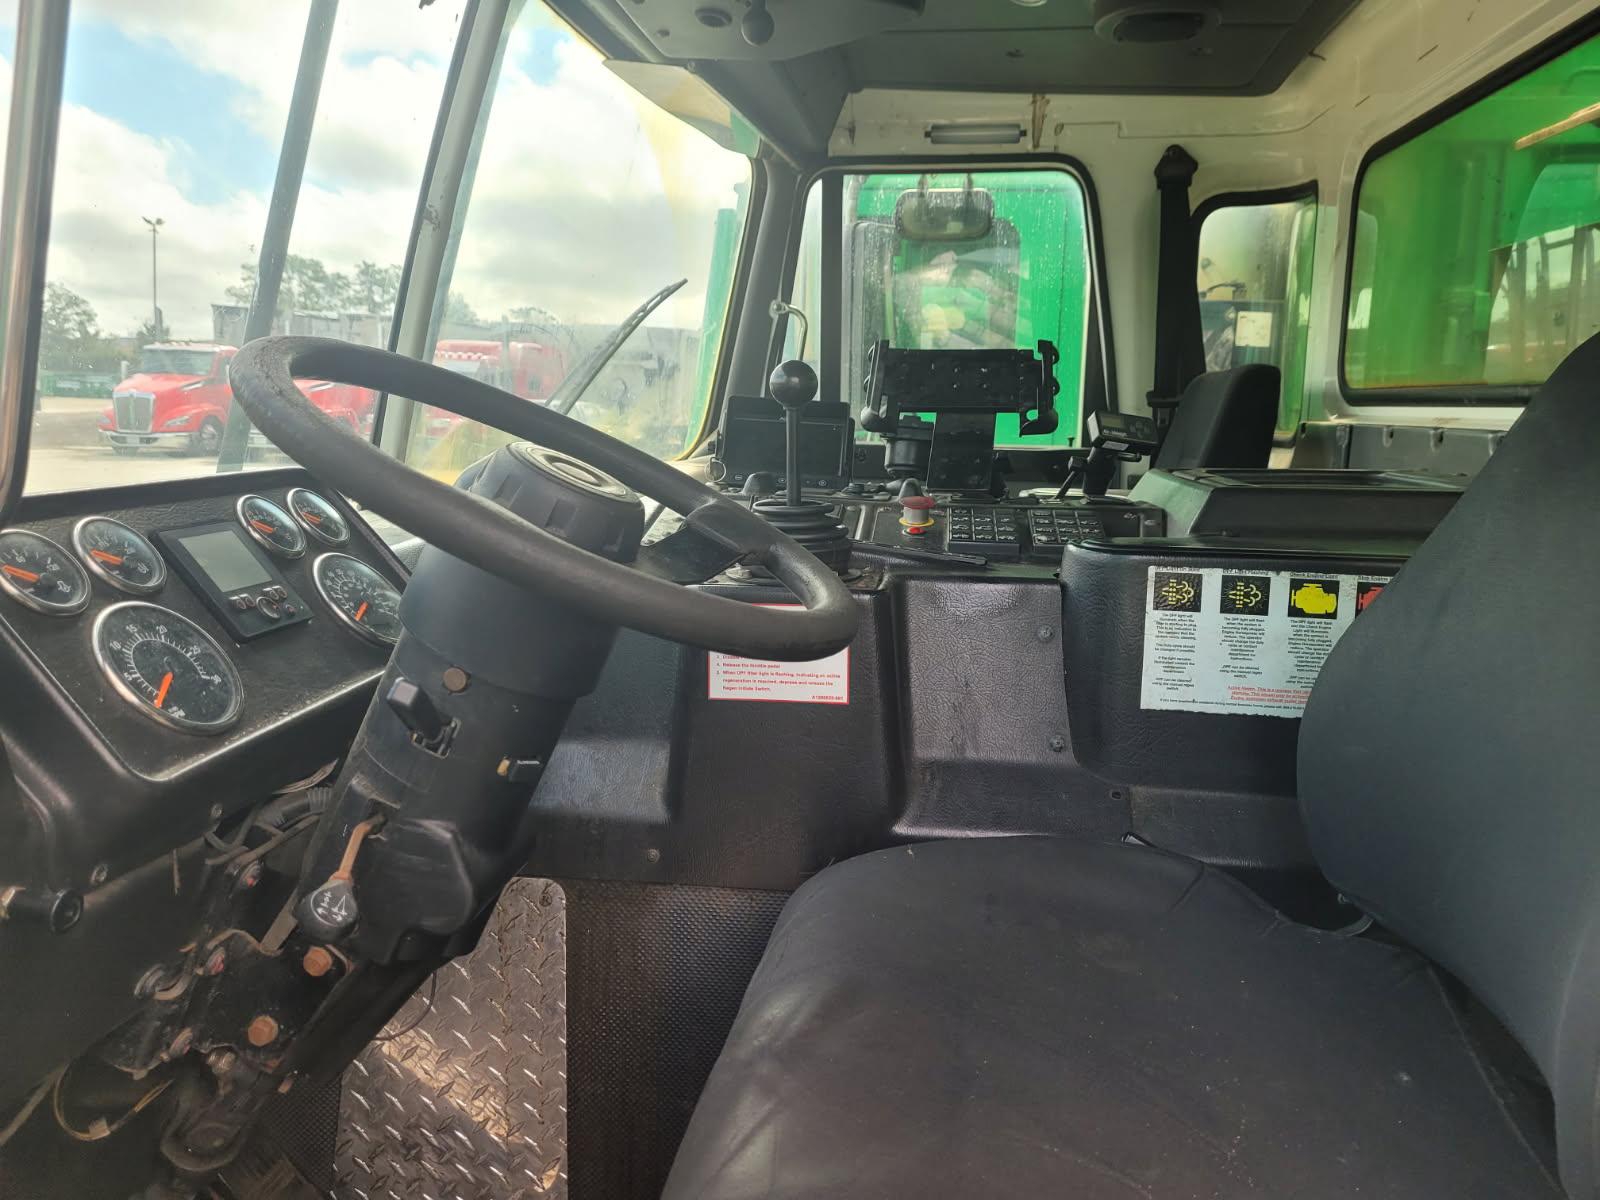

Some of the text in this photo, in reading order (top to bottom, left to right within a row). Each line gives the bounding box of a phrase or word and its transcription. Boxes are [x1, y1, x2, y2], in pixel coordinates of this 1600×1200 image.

[125, 623, 138, 634] 15
[156, 624, 169, 635] 20
[109, 641, 122, 651] 10
[123, 673, 133, 682] 5
